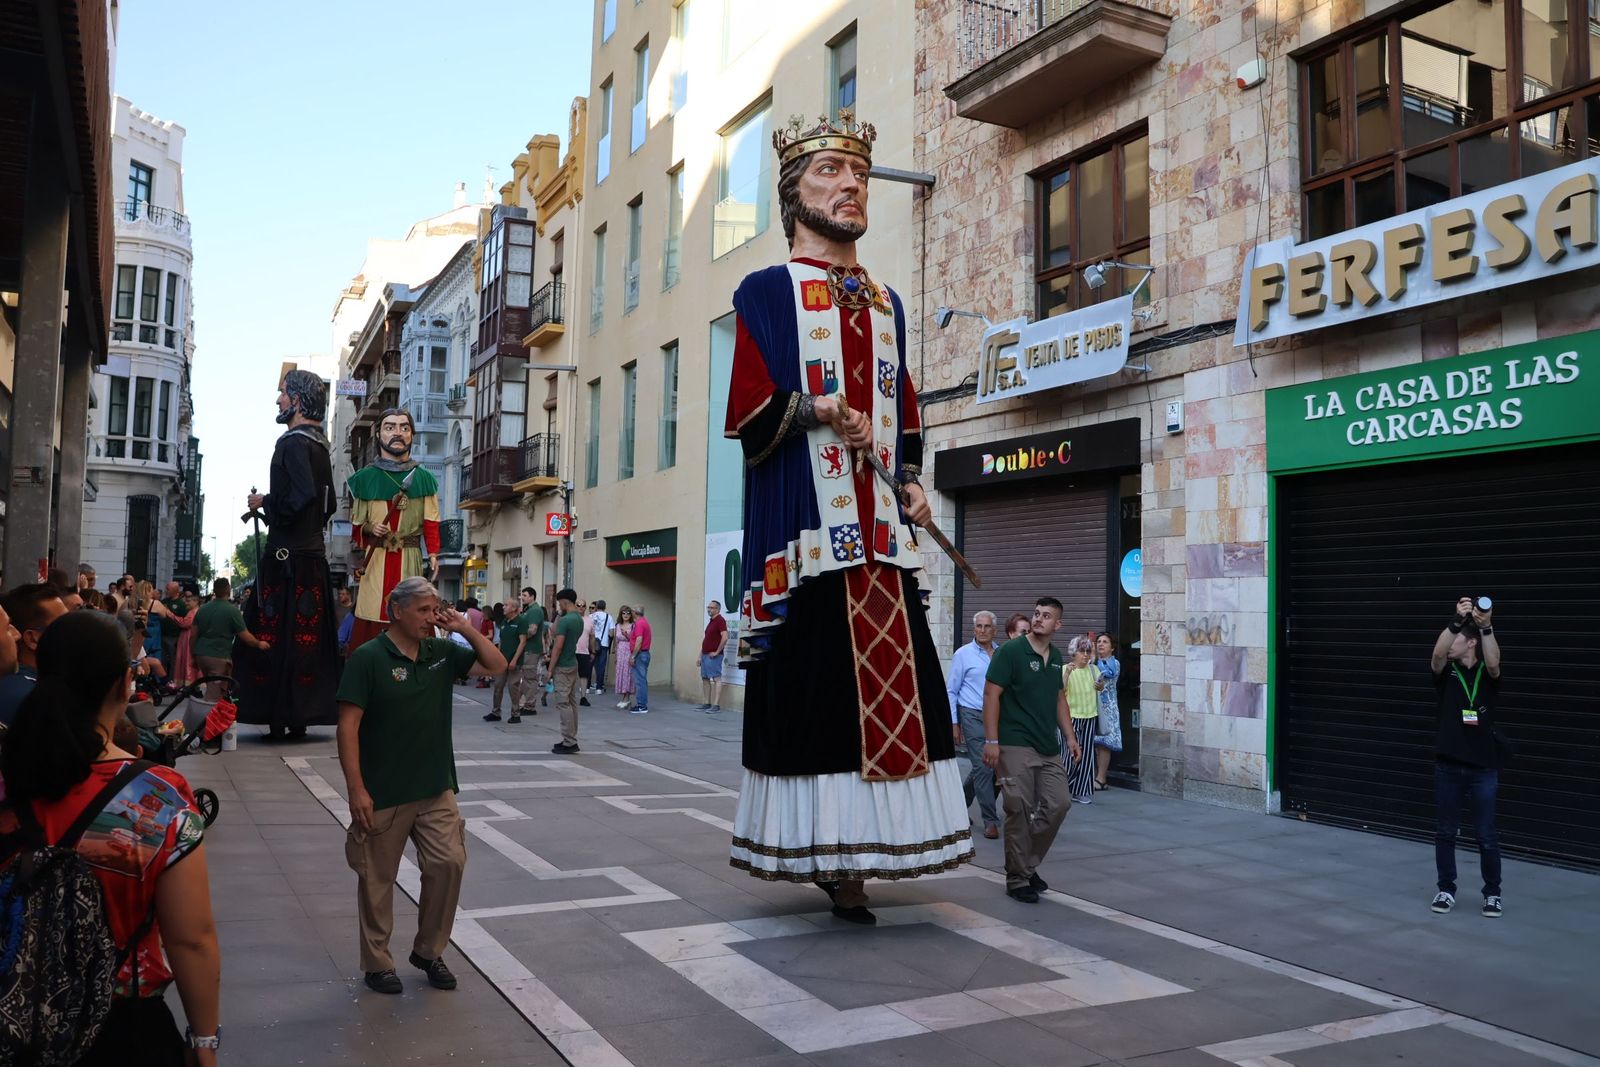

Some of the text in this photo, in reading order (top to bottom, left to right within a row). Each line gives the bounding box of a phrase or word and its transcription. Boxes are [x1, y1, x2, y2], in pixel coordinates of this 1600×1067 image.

[1250, 172, 1598, 332] FERFESA
[1024, 323, 1123, 369] VENTA DE PISOS
[998, 371, 1027, 391] S.A.
[1304, 350, 1580, 421] LA CASA DE LAS
[1346, 397, 1524, 446] CARCASAS
[630, 544, 660, 558] Unicaja Banco
